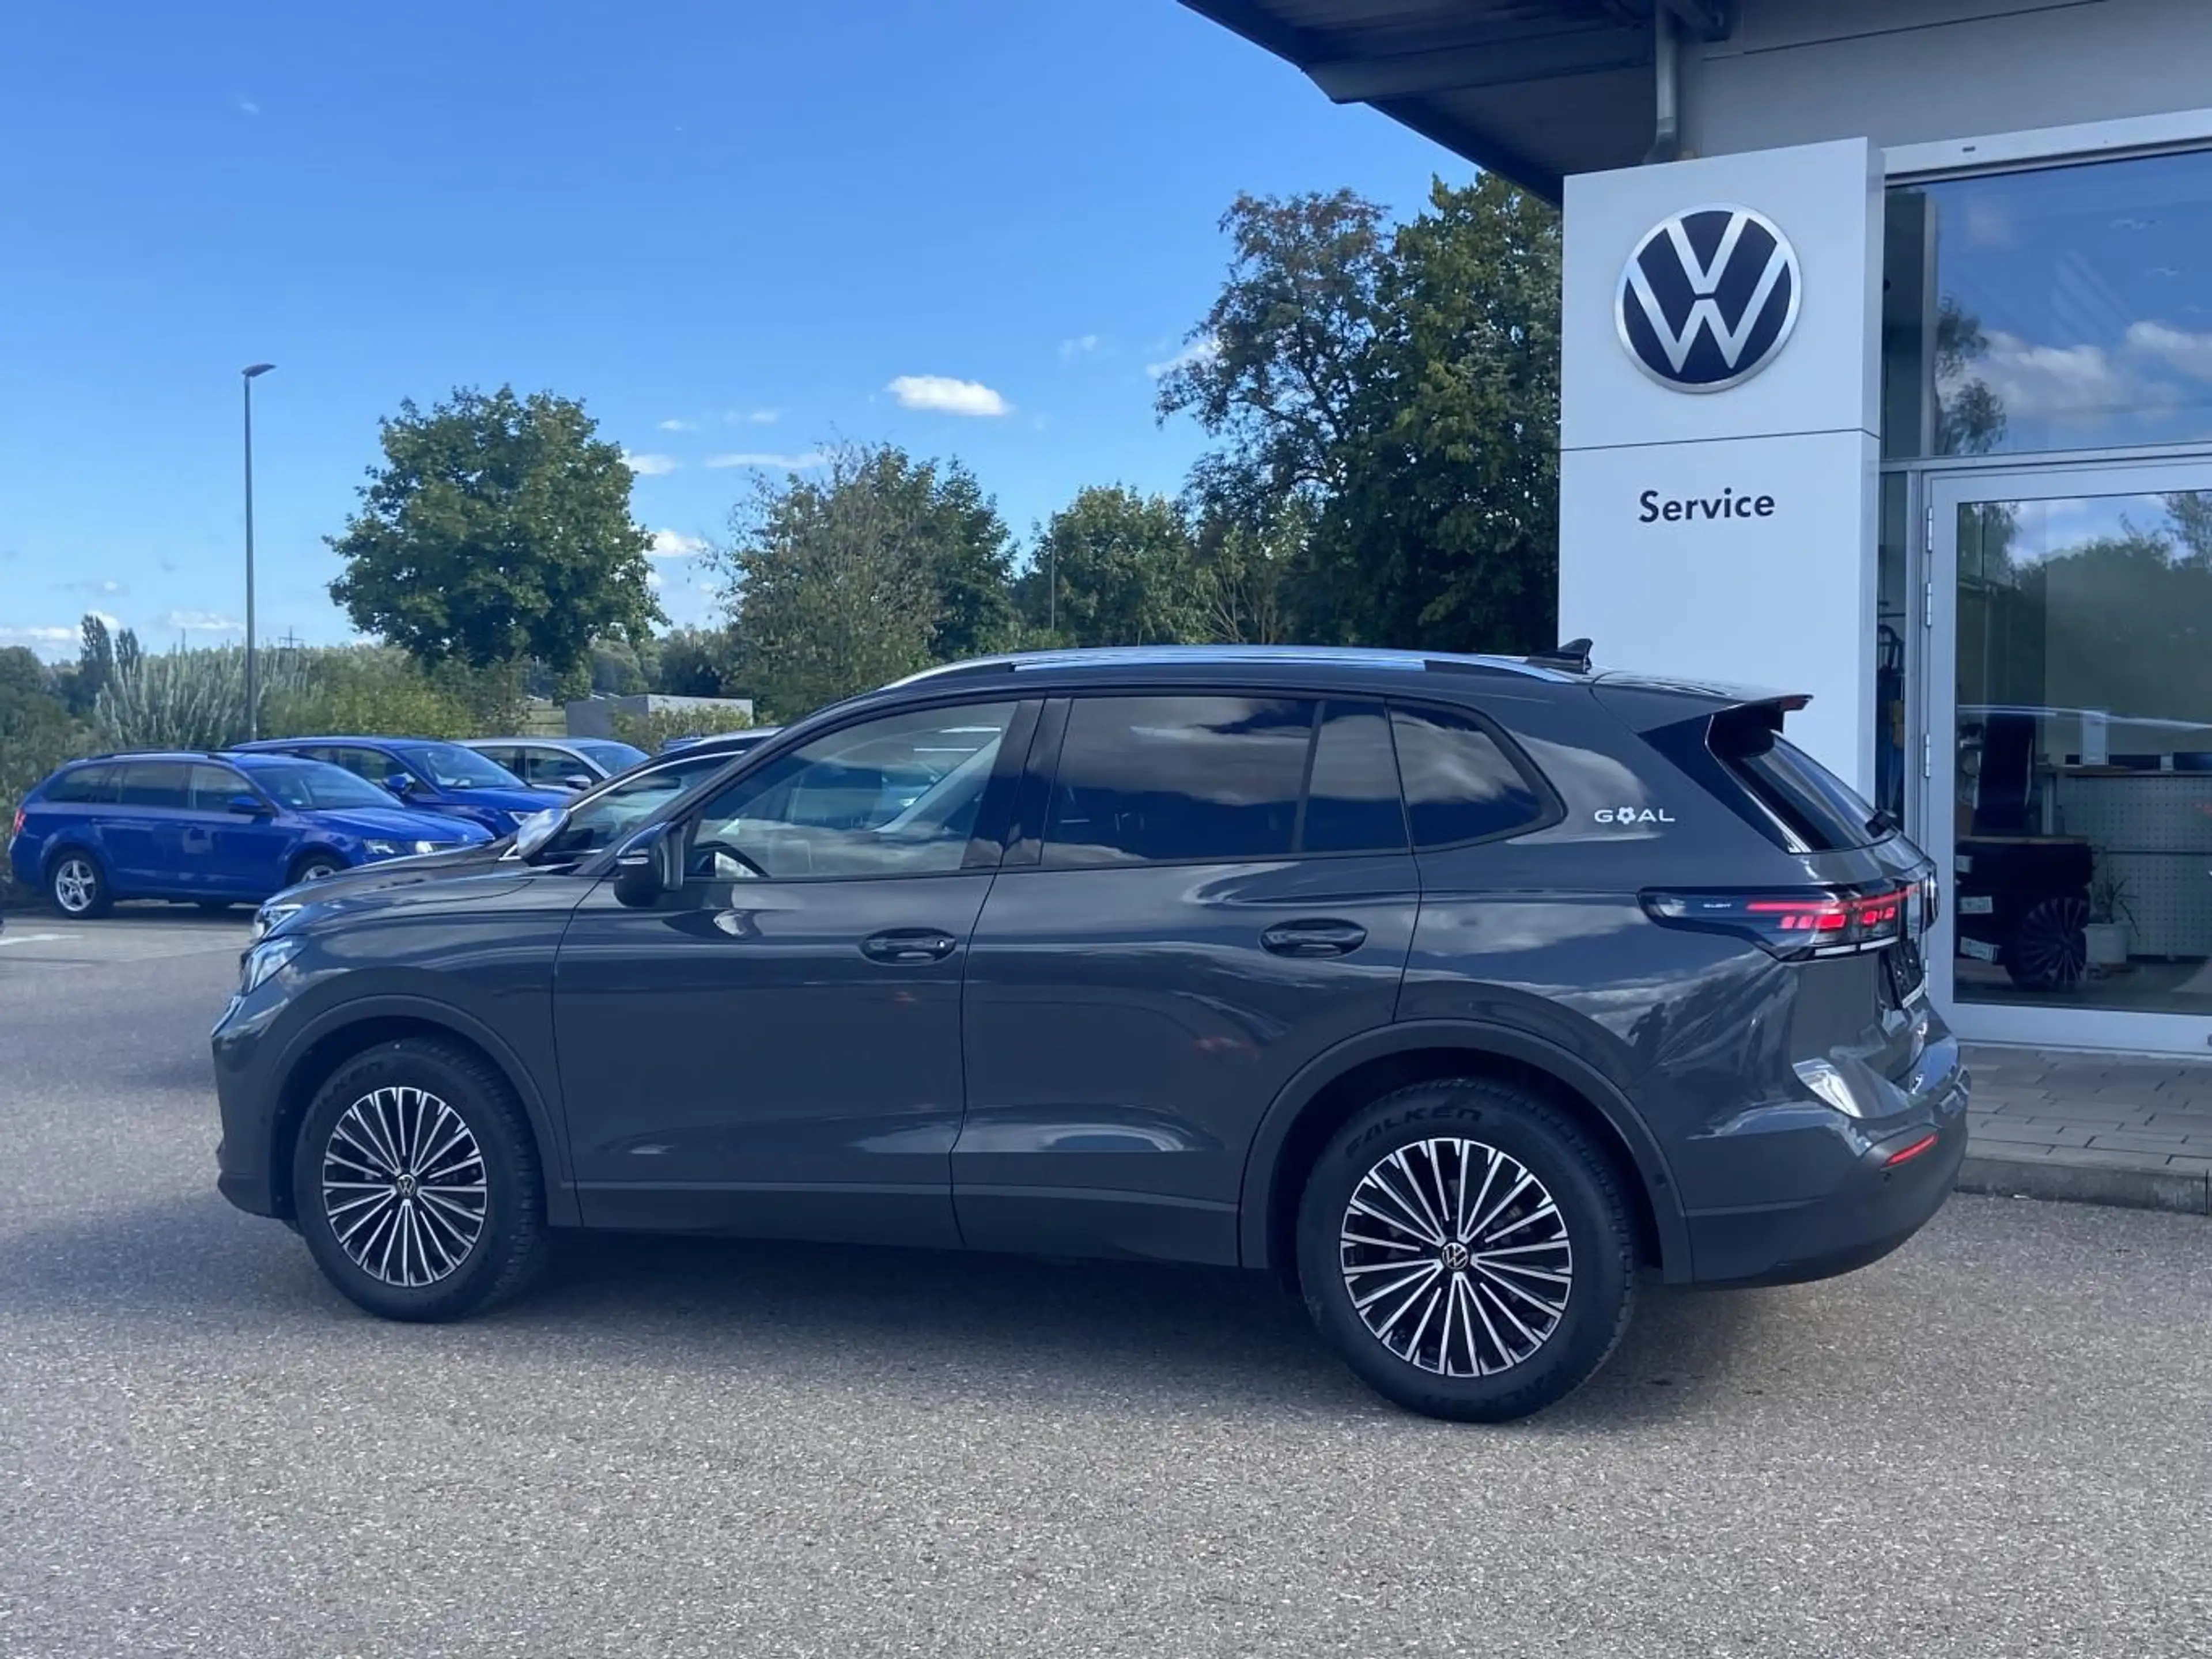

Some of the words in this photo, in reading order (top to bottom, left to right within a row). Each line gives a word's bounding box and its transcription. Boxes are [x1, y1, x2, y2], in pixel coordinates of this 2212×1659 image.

[1639, 487, 1775, 522] Service
[1594, 806, 1676, 824] GOAL
[1345, 1105, 1483, 1158] FALKEN
